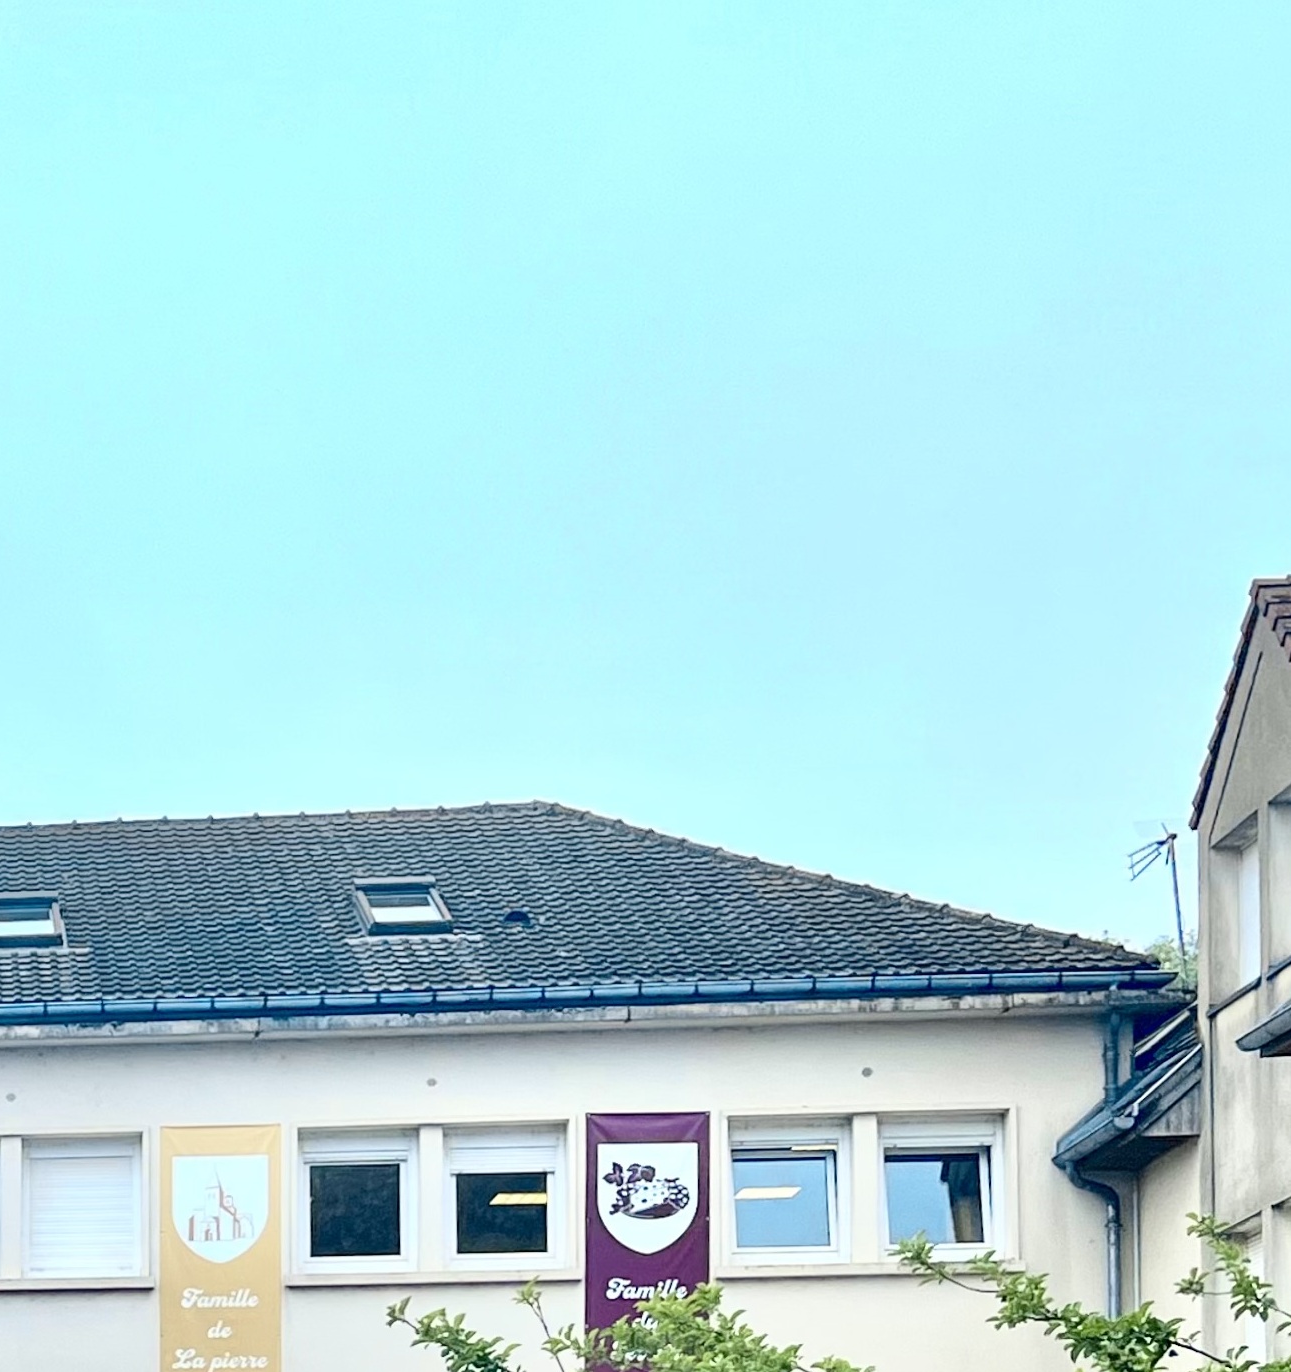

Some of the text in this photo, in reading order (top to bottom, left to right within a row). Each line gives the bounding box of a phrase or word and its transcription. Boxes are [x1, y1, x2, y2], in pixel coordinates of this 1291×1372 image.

[180, 1287, 259, 1309] Famille
[605, 1277, 688, 1300] Famille
[207, 1320, 233, 1339] de
[172, 1348, 206, 1370] La
